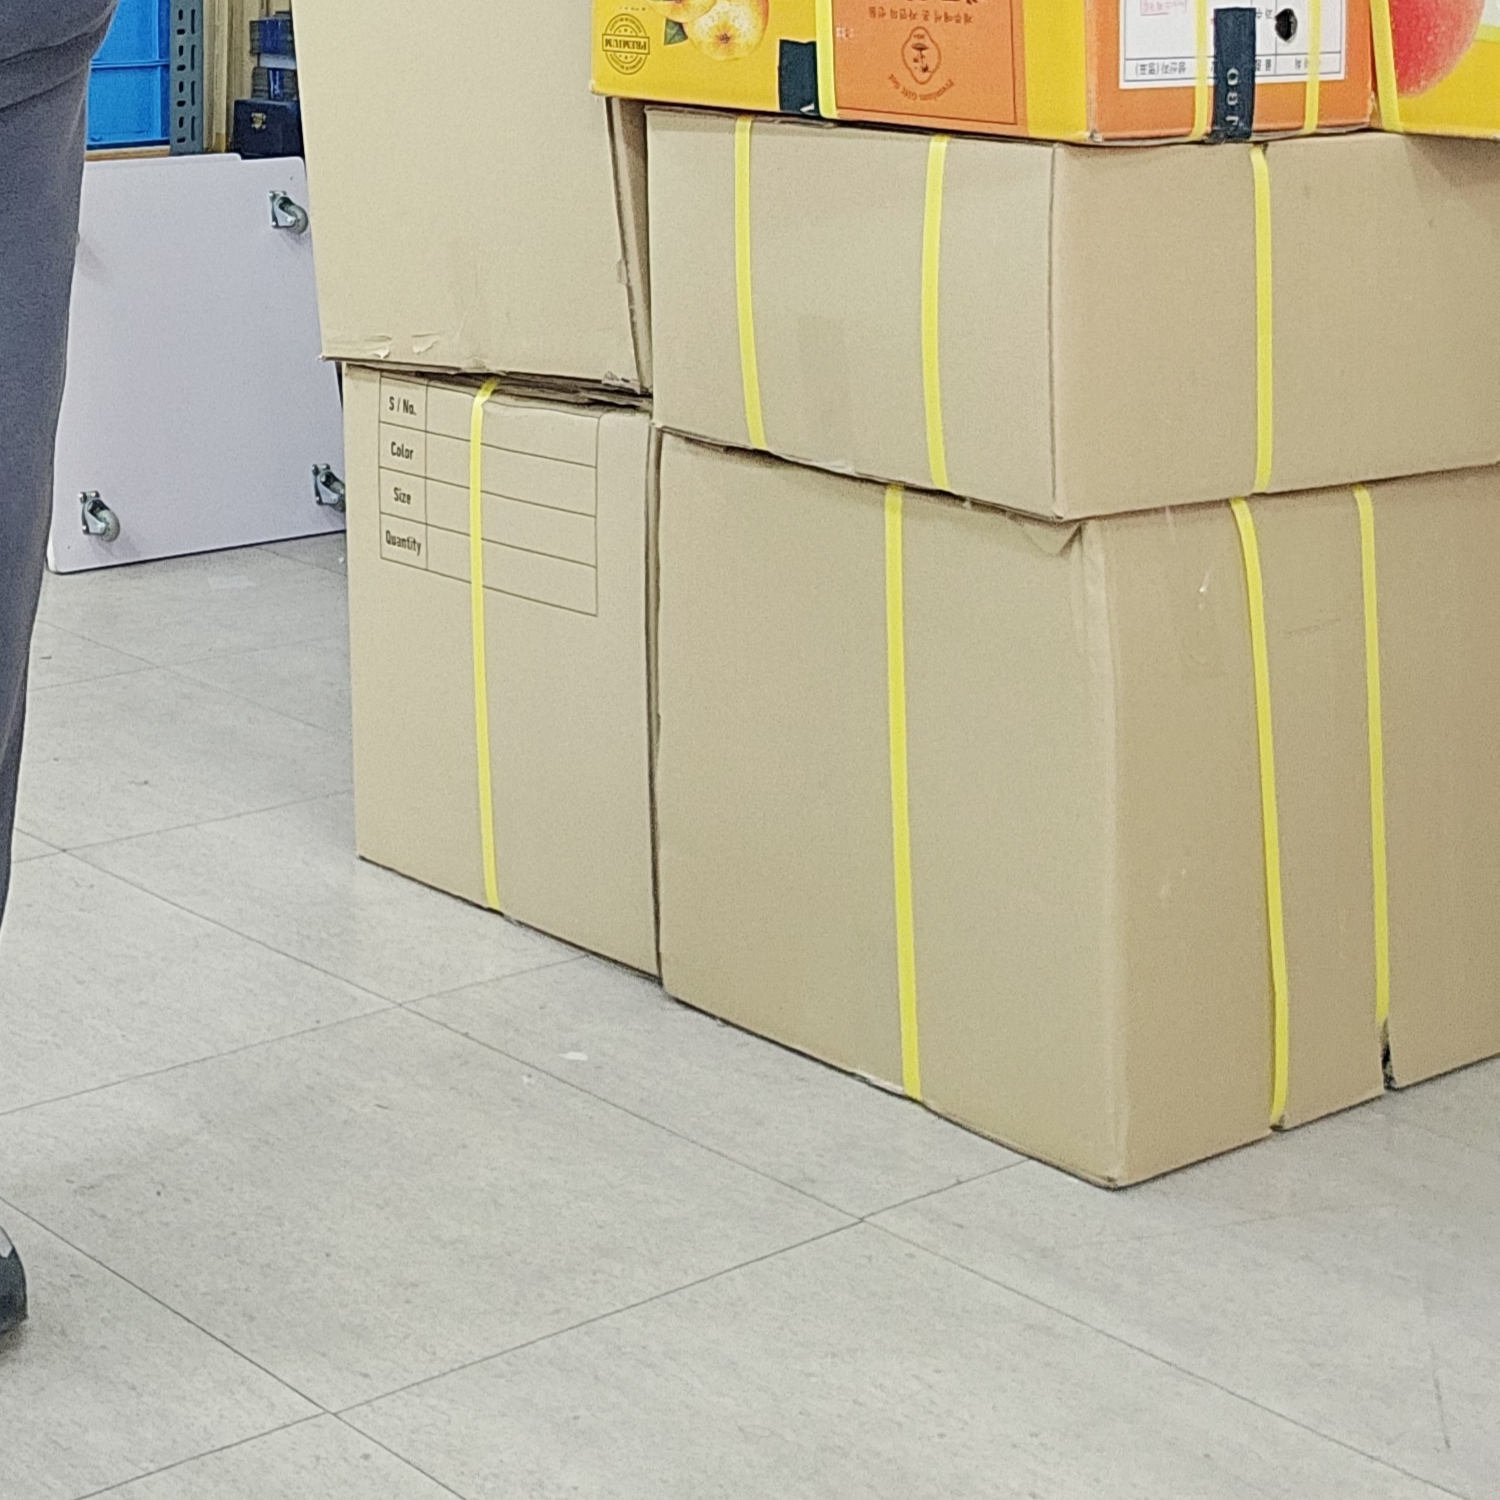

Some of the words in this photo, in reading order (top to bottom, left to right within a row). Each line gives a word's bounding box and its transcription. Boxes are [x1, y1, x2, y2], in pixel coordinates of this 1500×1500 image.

[604, 38, 647, 51] PREMIUM
[390, 441, 415, 460] Color
[393, 487, 412, 505] Size
[385, 530, 422, 557] Quantity
